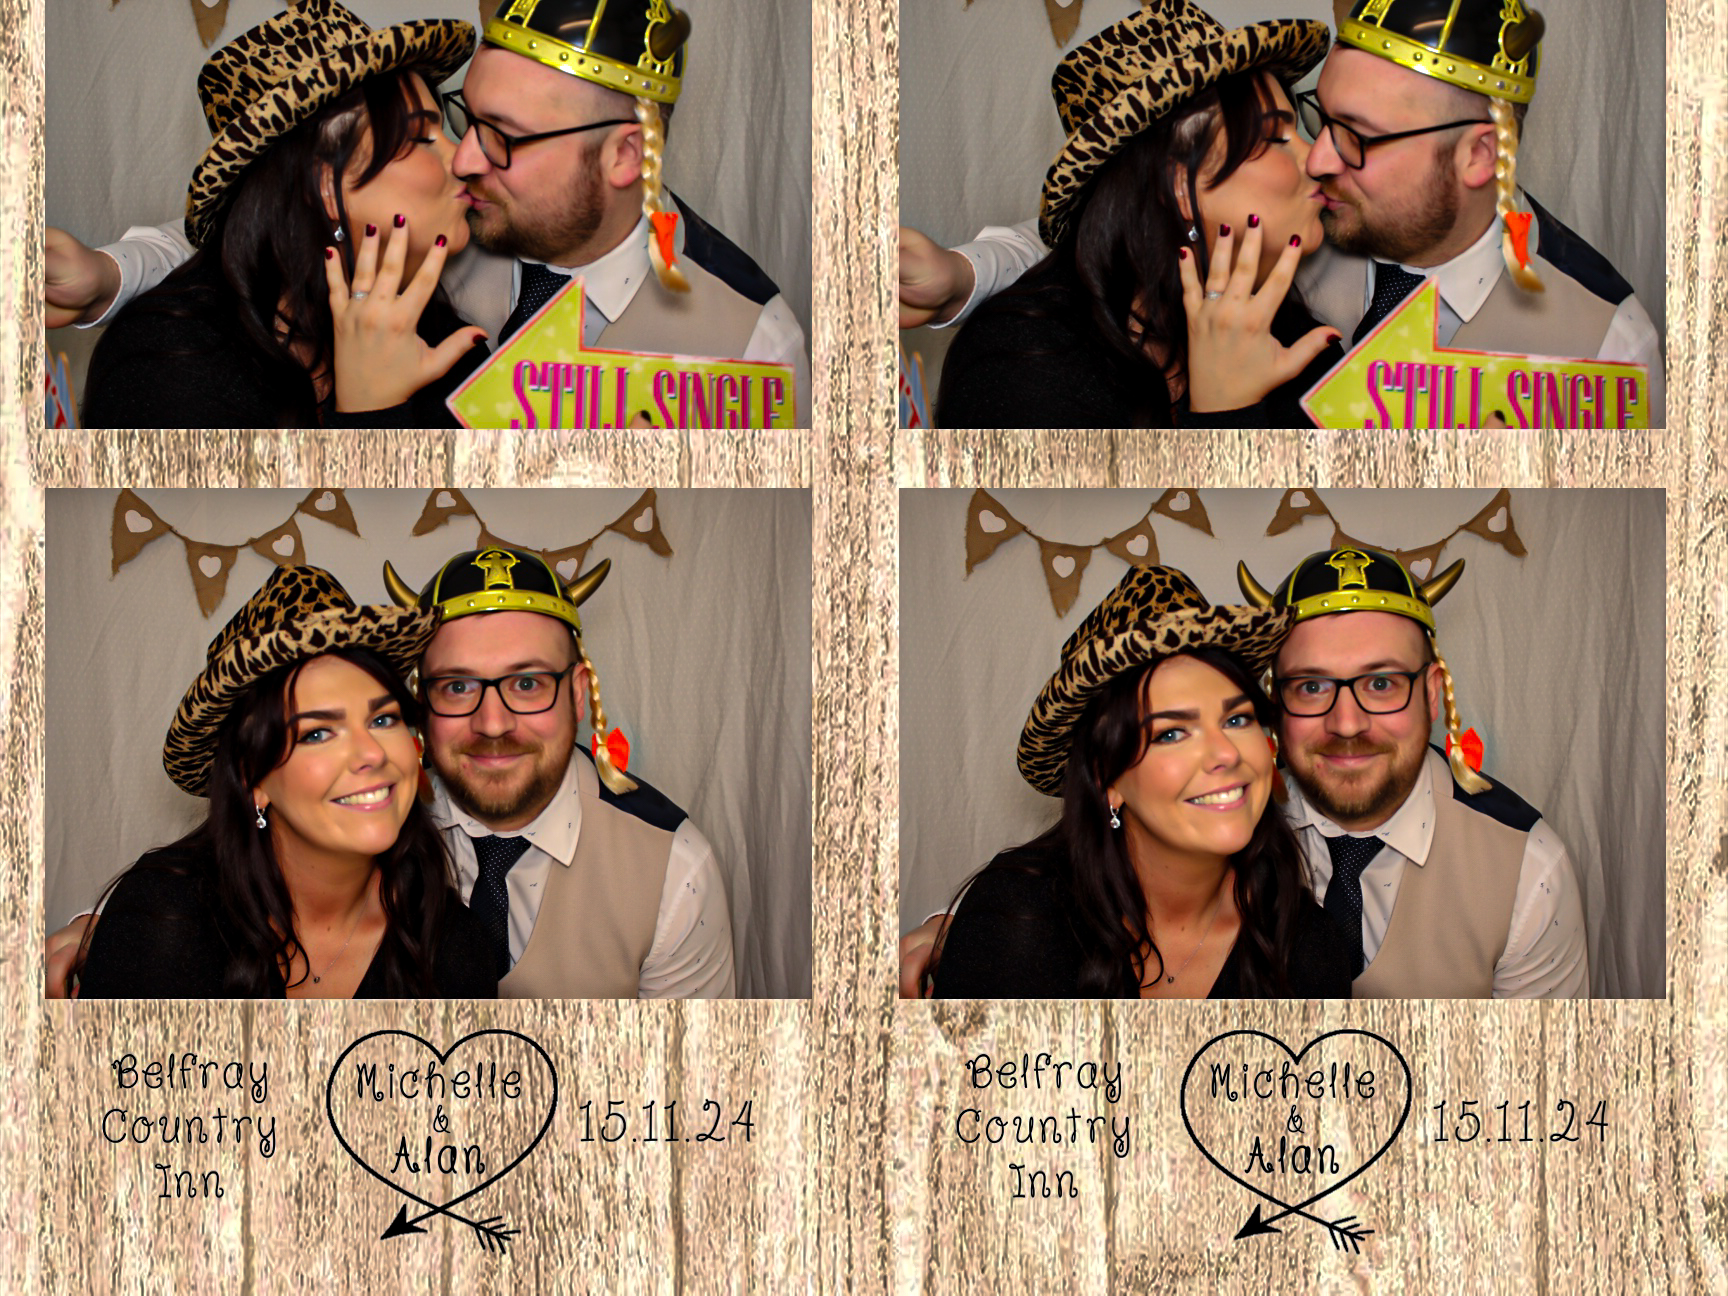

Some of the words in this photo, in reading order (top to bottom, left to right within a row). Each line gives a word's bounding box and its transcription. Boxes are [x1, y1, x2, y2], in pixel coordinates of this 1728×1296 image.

[510, 359, 631, 429] STILL
[652, 369, 785, 429] SINGLE
[1364, 359, 1485, 429] STILL
[1506, 369, 1639, 429] SINGLE
